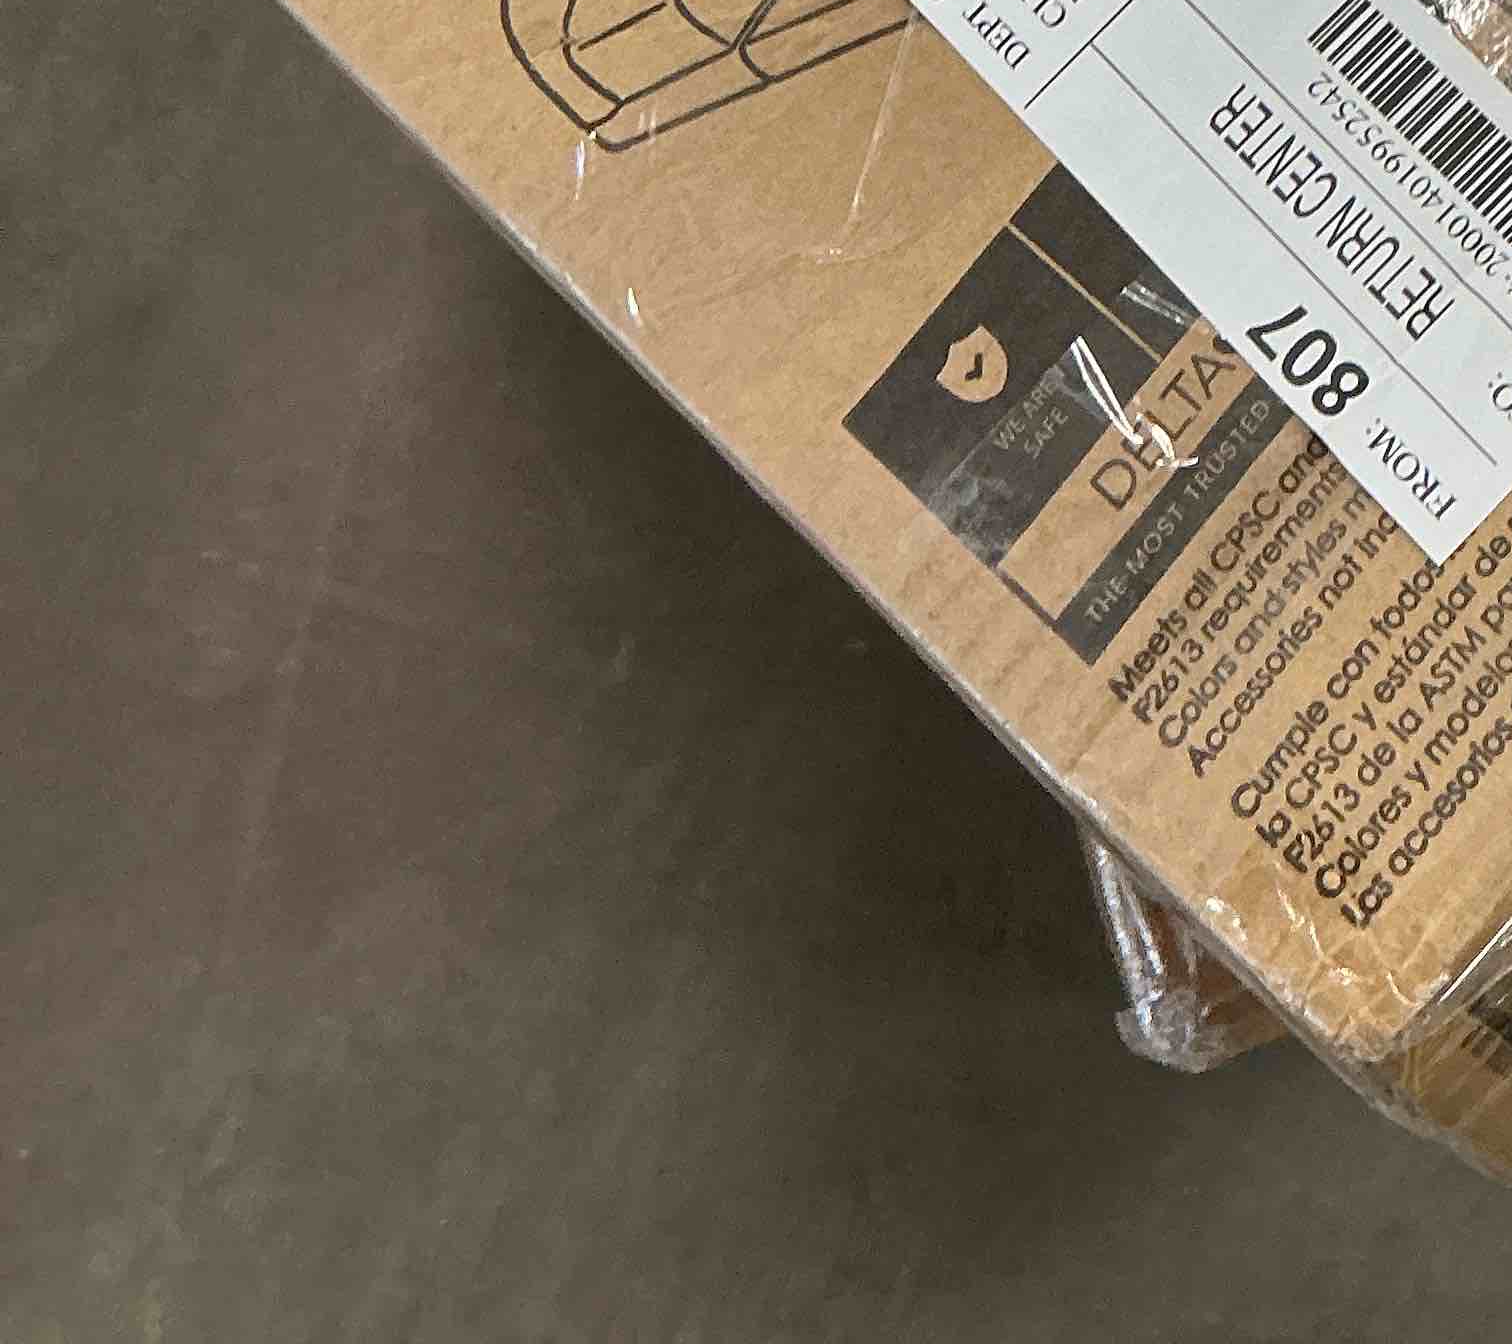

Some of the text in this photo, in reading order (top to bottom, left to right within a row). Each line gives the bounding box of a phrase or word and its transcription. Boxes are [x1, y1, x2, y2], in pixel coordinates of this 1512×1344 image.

[962, 1, 1030, 70] DEPT
[1209, 83, 1338, 218] CENTER
[1307, 71, 1510, 277] 200014019952542
[1315, 195, 1456, 342] RETURN
[1084, 399, 1270, 622] THE MOST TRUSTED
[1245, 305, 1457, 521] FROM: 807
[1107, 609, 1188, 704] Meets
[1183, 567, 1218, 613] all
[1209, 489, 1281, 574] CPSC
[1131, 637, 1205, 725] F2613
[1158, 520, 1347, 749] Colors and styles
[1187, 605, 1324, 779] Accessories
[1317, 552, 1363, 611] not
[1254, 810, 1293, 849] la
[1284, 723, 1358, 812] CPSC
[1351, 701, 1377, 731] y
[1373, 571, 1478, 705] estándar
[1474, 535, 1512, 578] de
[1230, 700, 1330, 820] Cumple
[1326, 637, 1381, 701] con
[1282, 783, 1361, 875] F2613
[1357, 741, 1397, 787] de
[1385, 706, 1425, 745] la
[1419, 625, 1487, 713] ASTM
[1314, 785, 1412, 900] Colores
[1403, 758, 1431, 792] y
